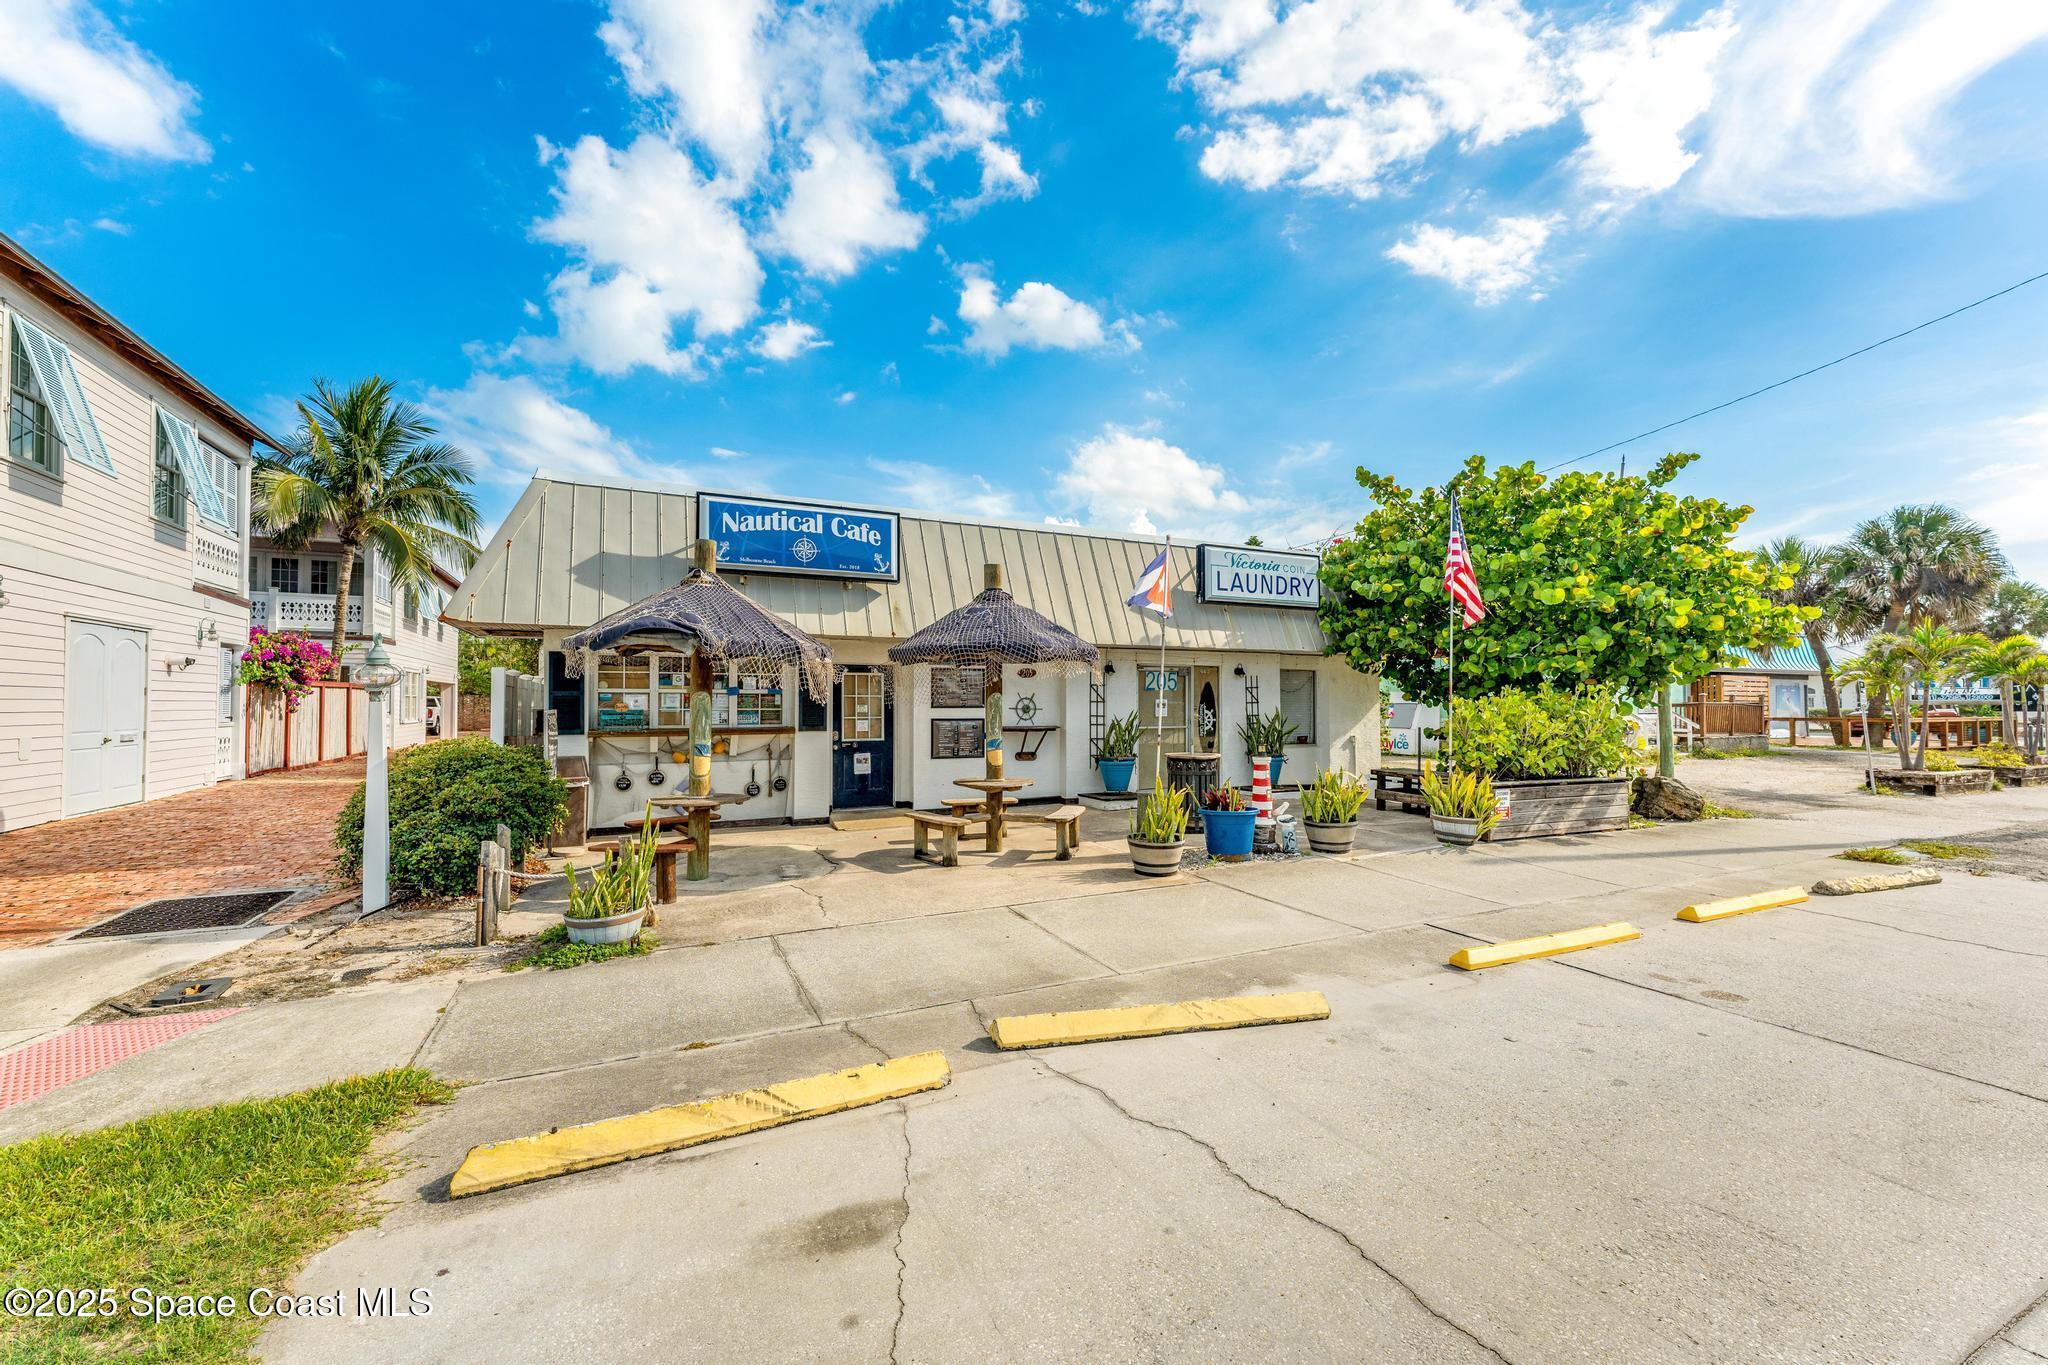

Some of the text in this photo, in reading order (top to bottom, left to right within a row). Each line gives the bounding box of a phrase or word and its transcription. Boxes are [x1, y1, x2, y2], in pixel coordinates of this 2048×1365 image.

[722, 511, 882, 546] Nautical Cafe
[1224, 552, 1306, 574] Victoria COIN
[1217, 571, 1315, 598] LAUNDRY
[1145, 671, 1177, 691] 205
